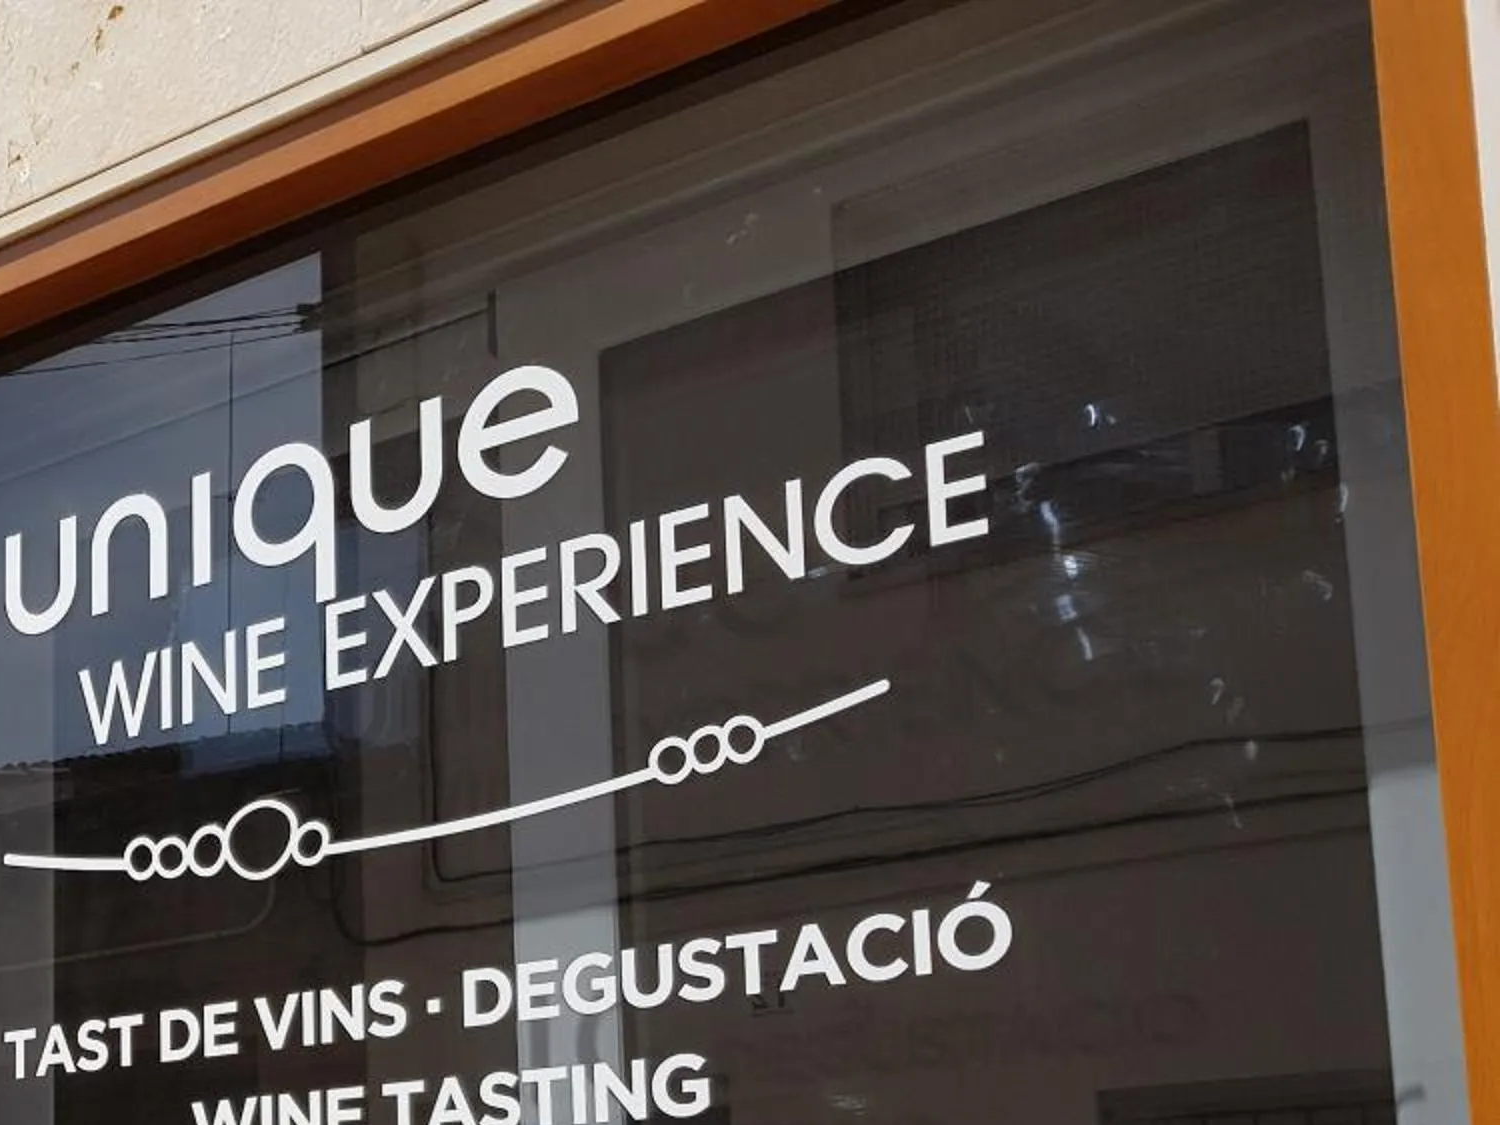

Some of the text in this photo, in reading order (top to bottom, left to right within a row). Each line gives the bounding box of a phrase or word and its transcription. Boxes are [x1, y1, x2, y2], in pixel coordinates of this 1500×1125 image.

[4, 364, 580, 636] unique
[78, 430, 990, 746] WINE EXPERIENCE
[3, 1011, 145, 1080] TAST
[159, 999, 240, 1063] DE
[253, 978, 408, 1051] VINS
[462, 880, 1013, 1028] DEGUSTACIÓ
